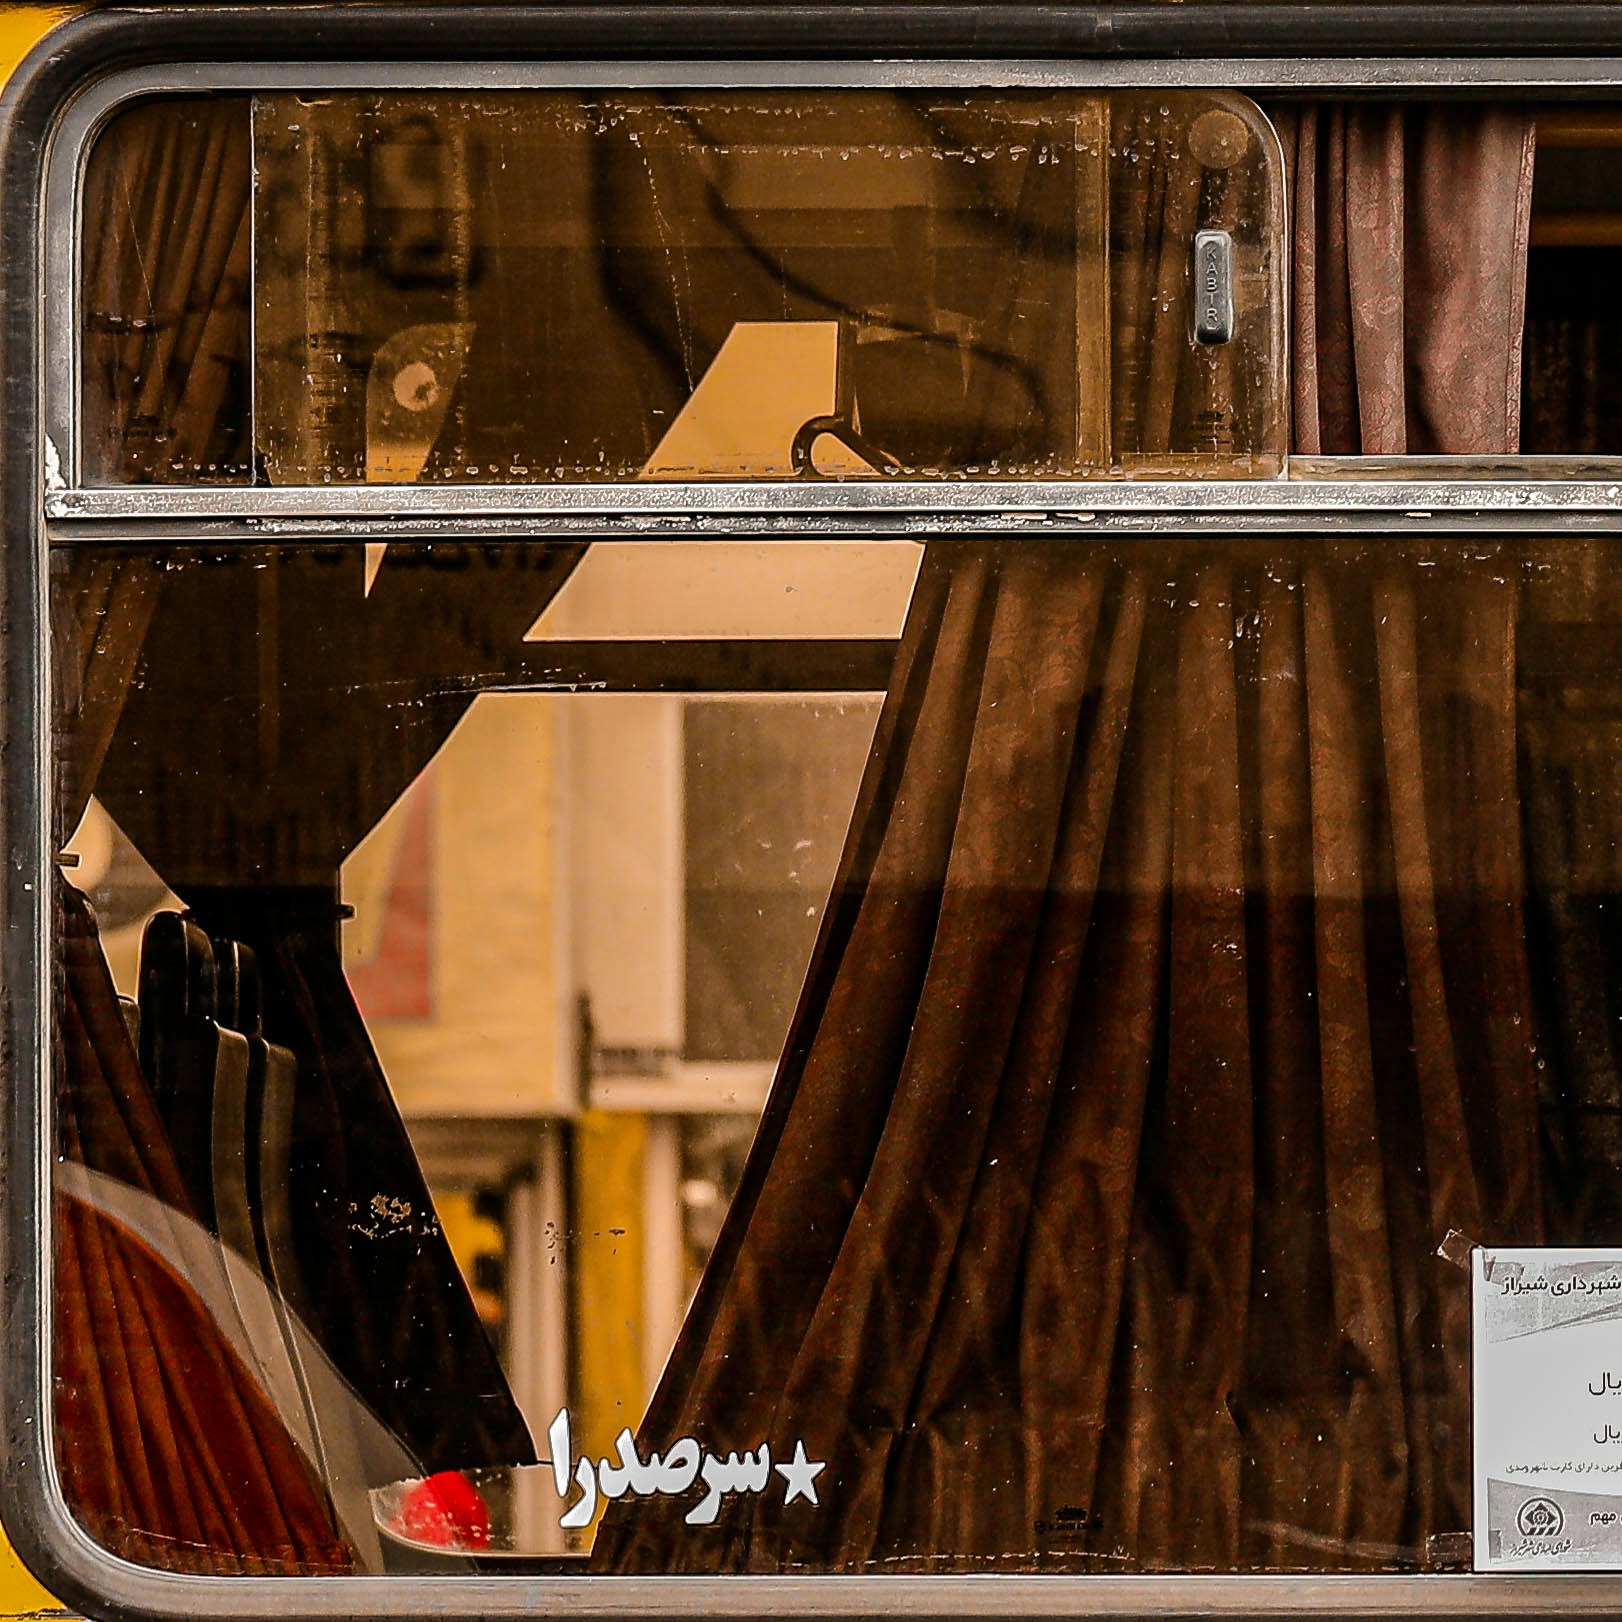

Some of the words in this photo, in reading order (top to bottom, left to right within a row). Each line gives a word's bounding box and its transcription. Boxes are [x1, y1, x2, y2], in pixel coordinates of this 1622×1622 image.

[1205, 246, 1219, 324] KABIR
[1501, 1275, 1548, 1296] شیراز
[1550, 1274, 1622, 1297] شهرداری
[1590, 1513, 1616, 1526] مهم
